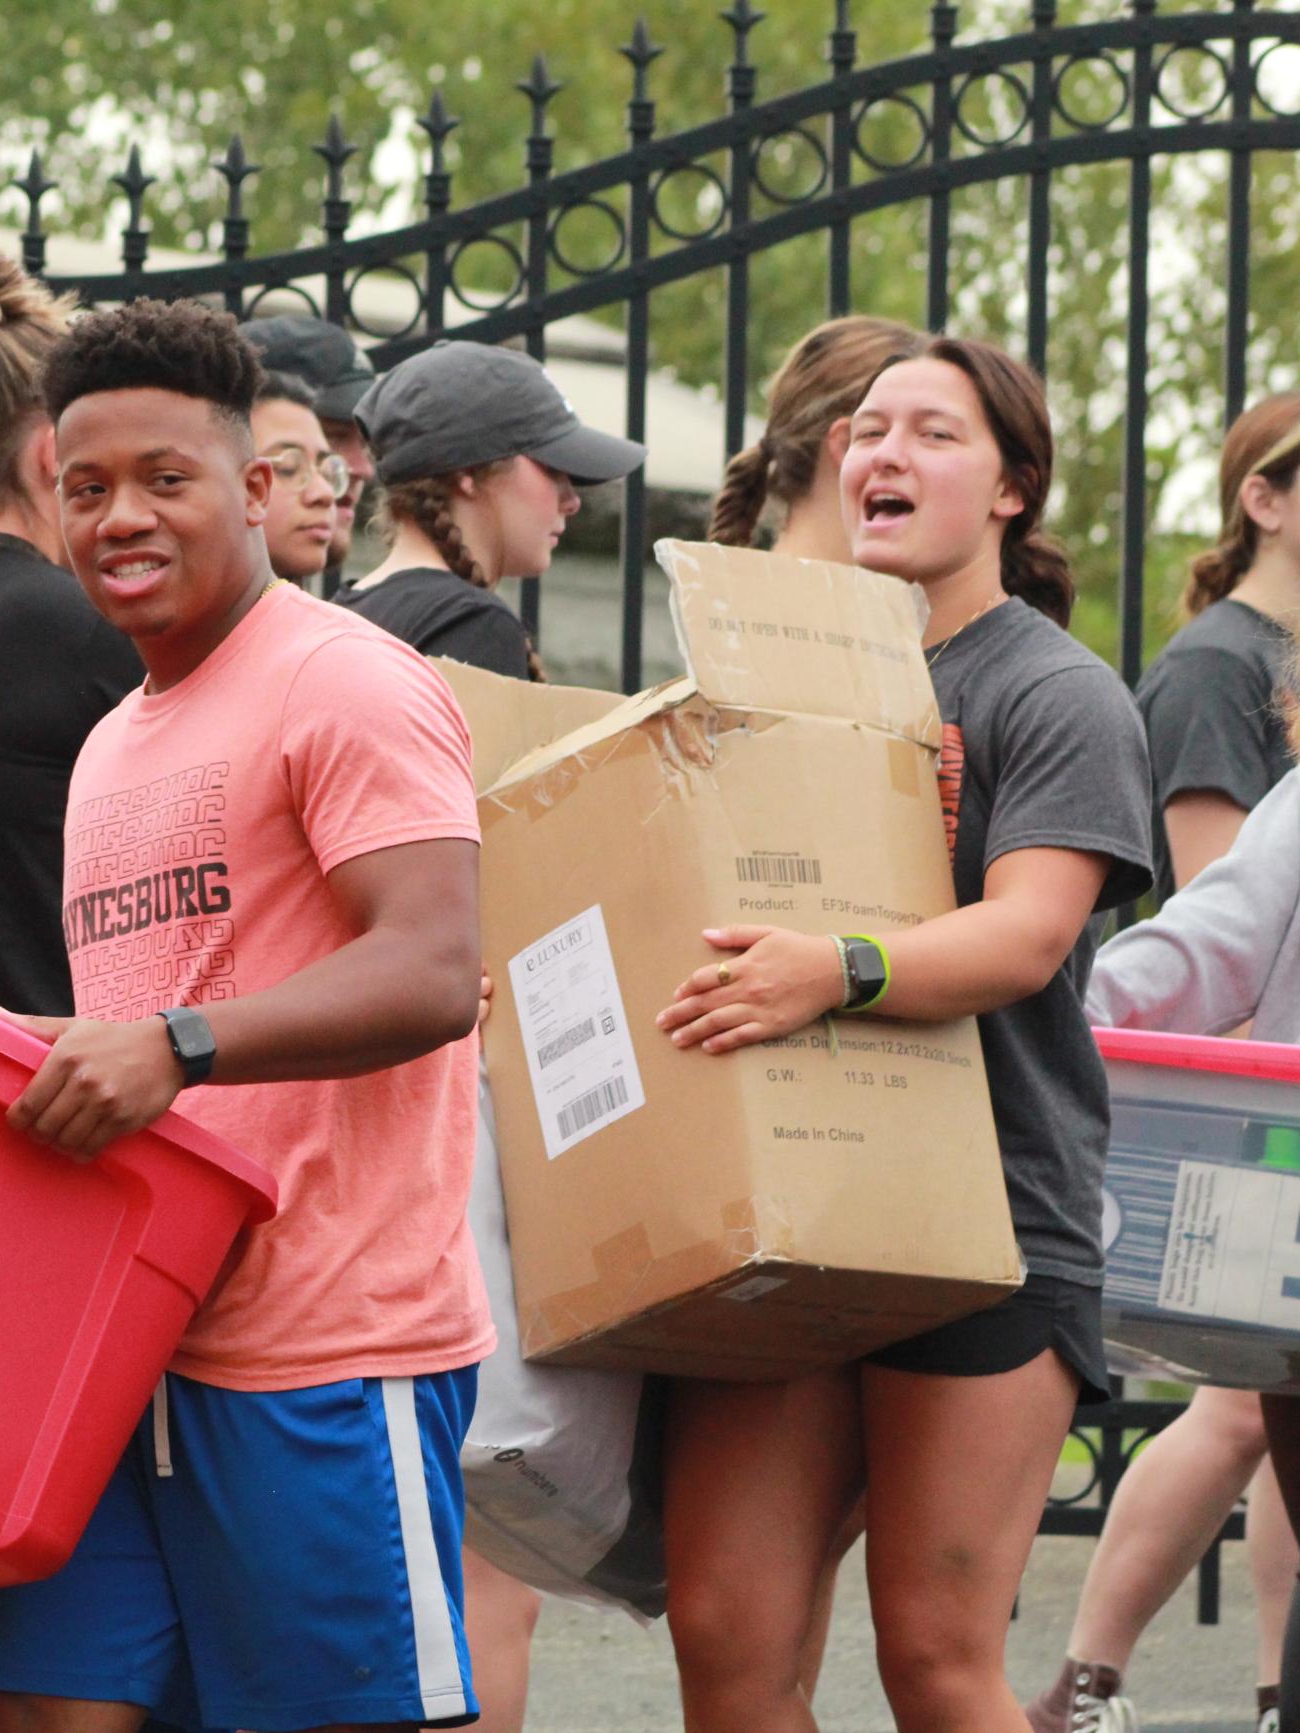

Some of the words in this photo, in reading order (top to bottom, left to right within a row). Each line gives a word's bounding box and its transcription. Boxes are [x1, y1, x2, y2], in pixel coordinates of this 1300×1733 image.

[752, 622, 778, 637] OPEN
[782, 626, 810, 641] WITH
[814, 632, 821, 643] A
[844, 1071, 875, 1085] 11.33
[884, 1074, 908, 1089] LBS
[773, 1126, 809, 1140] Made
[828, 1128, 865, 1142] China
